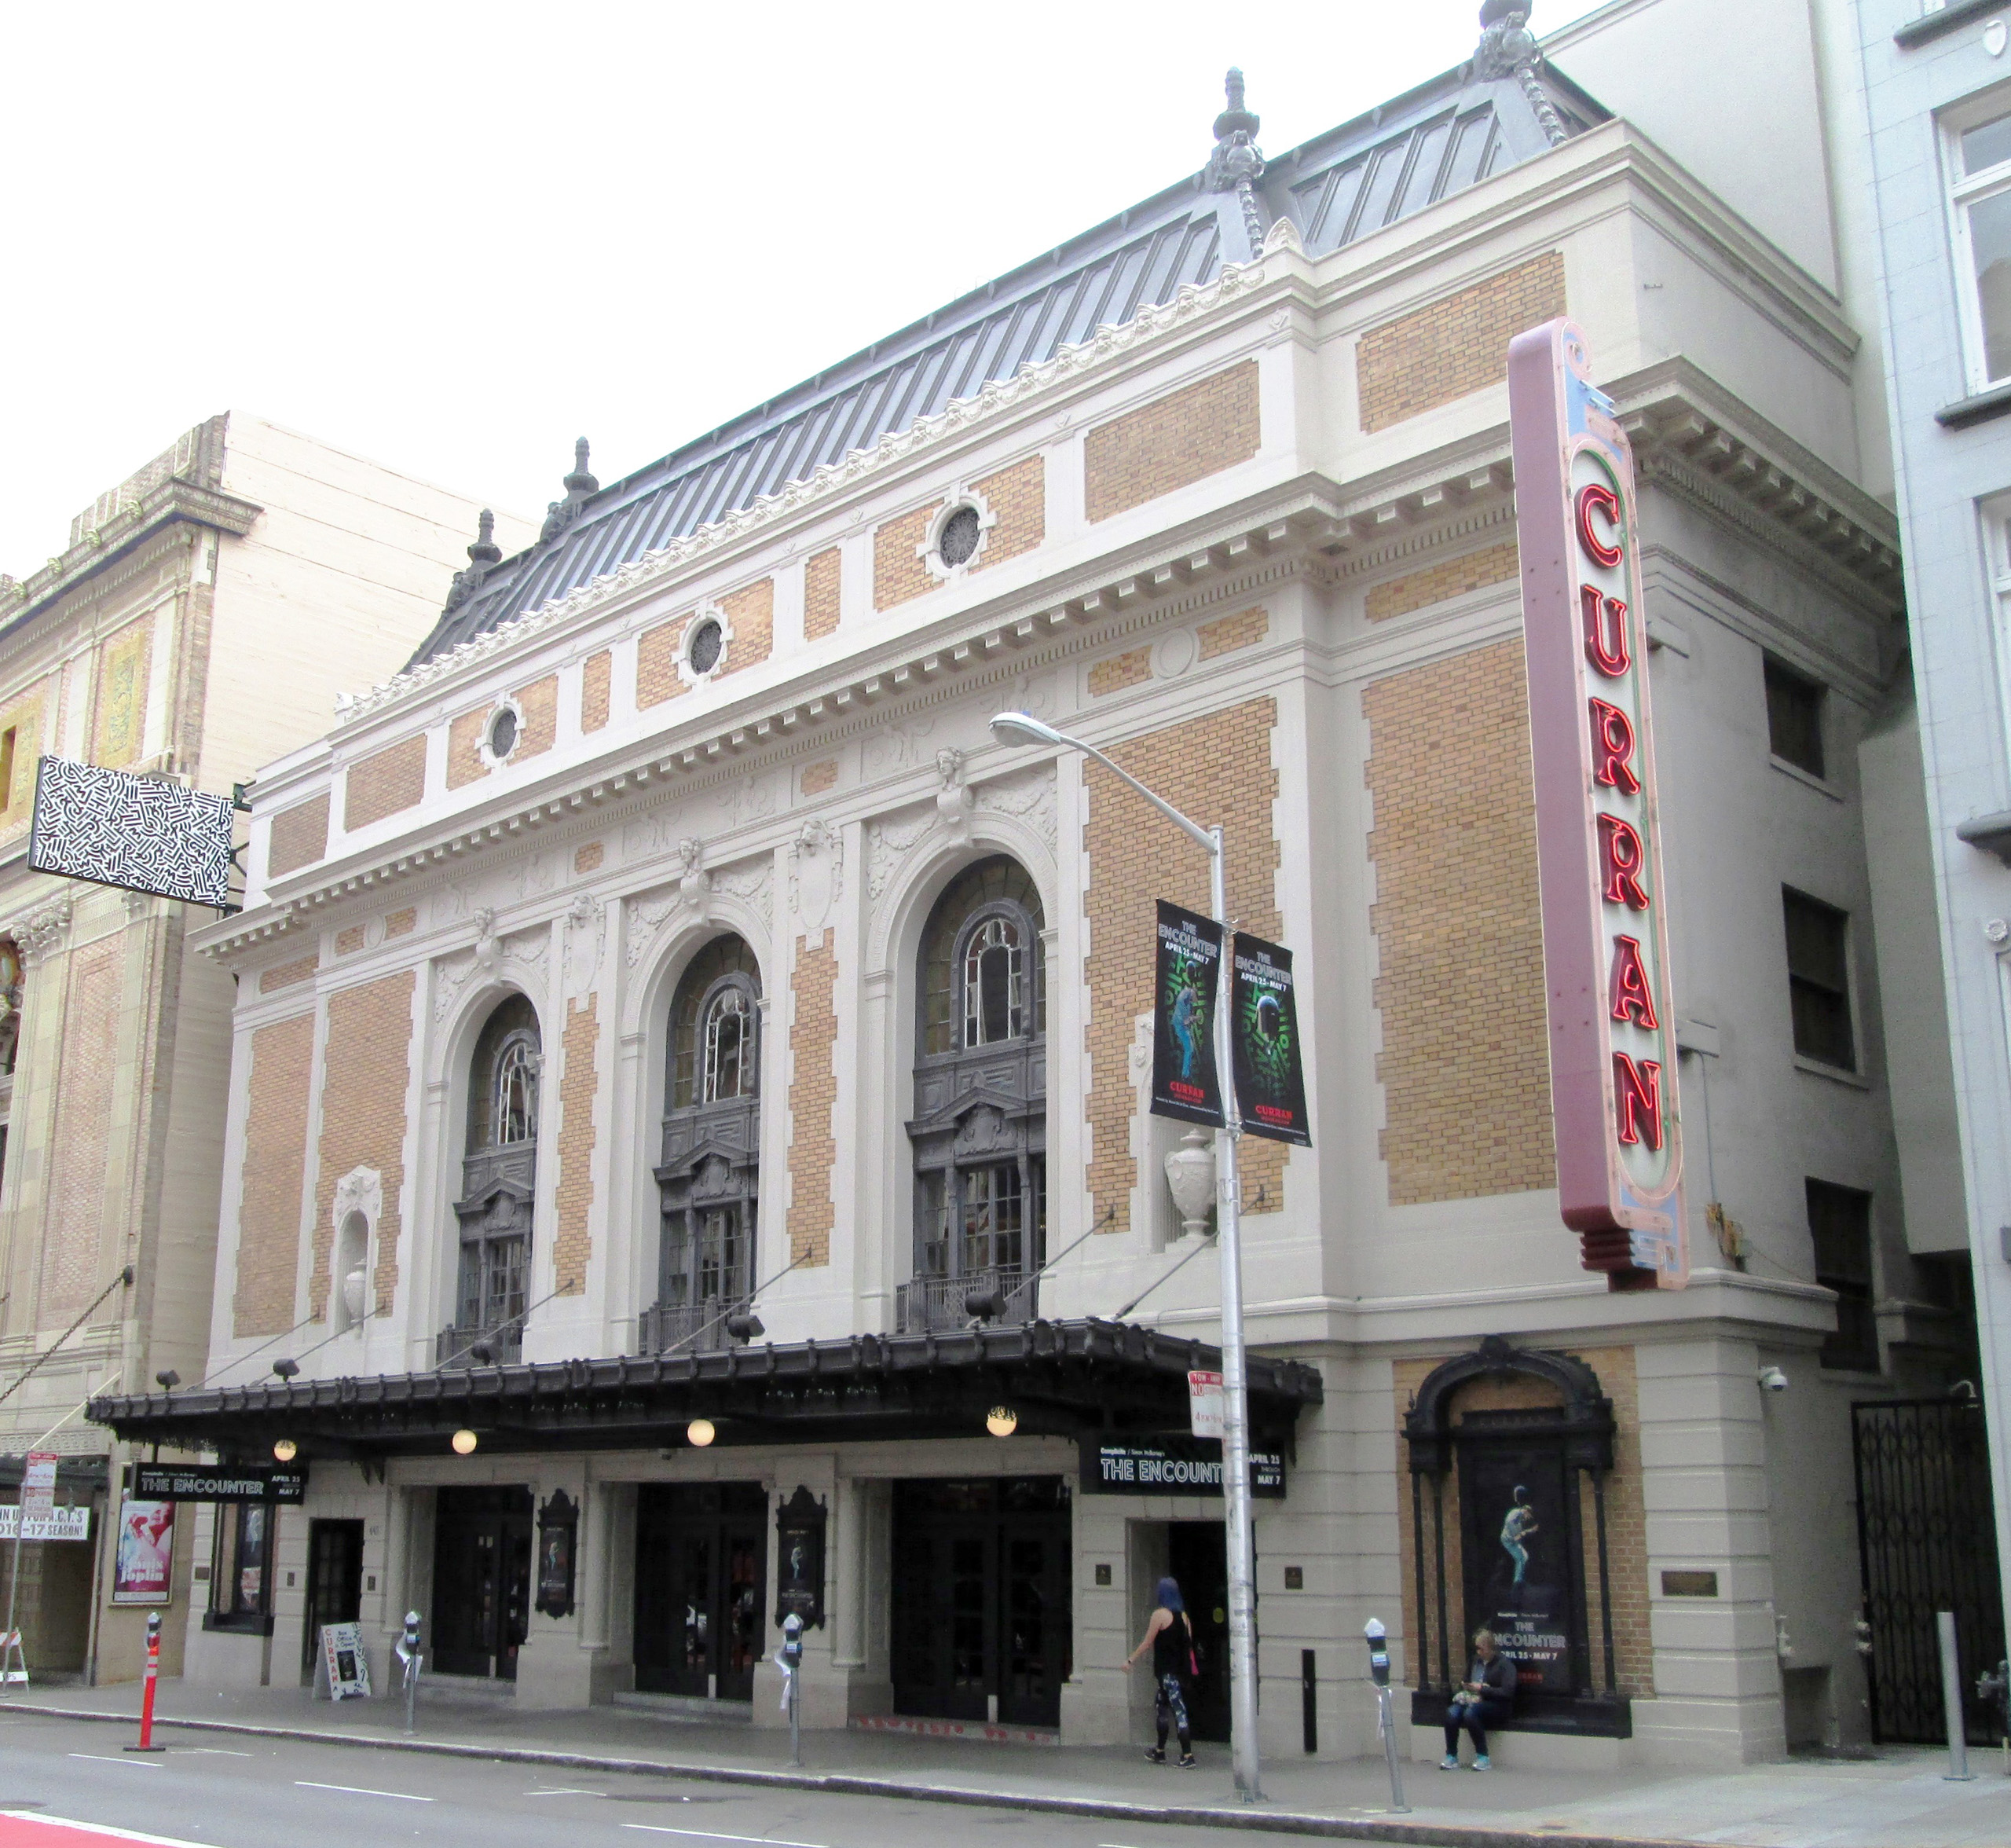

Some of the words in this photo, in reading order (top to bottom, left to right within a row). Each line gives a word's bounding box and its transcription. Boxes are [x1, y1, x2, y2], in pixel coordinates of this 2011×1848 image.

[1573, 482, 1662, 1152] CURRAN
[1181, 920, 1197, 936] THE
[1158, 923, 1218, 959] ENCOUNTER
[1164, 940, 1183, 954] APRIL
[1182, 947, 1190, 956] 25
[1192, 952, 1205, 963] MAY
[1257, 951, 1271, 966] THE
[1235, 955, 1292, 985] ENCOUNTER
[1240, 972, 1258, 984] APRIL
[1258, 977, 1266, 985] 25
[1269, 981, 1283, 991] MAY
[1169, 1080, 1204, 1098] CURRAN
[1255, 1105, 1293, 1120] CURRAN
[1101, 1458, 1134, 1480] THE
[1139, 1460, 1223, 1483] ENCOUNT
[1247, 1454, 1269, 1464] APRIL
[1270, 1454, 1280, 1464] 25
[141, 1478, 169, 1491] THE
[174, 1479, 264, 1494] ENCOUNTER
[1257, 1475, 1273, 1484] MAY
[1275, 1476, 1280, 1485] 7
[47, 1525, 82, 1536] SEASON!
[1515, 1622, 1534, 1631] THE
[1494, 1634, 1566, 1648] NCOUNTER
[324, 1629, 339, 1682] CURRAN
